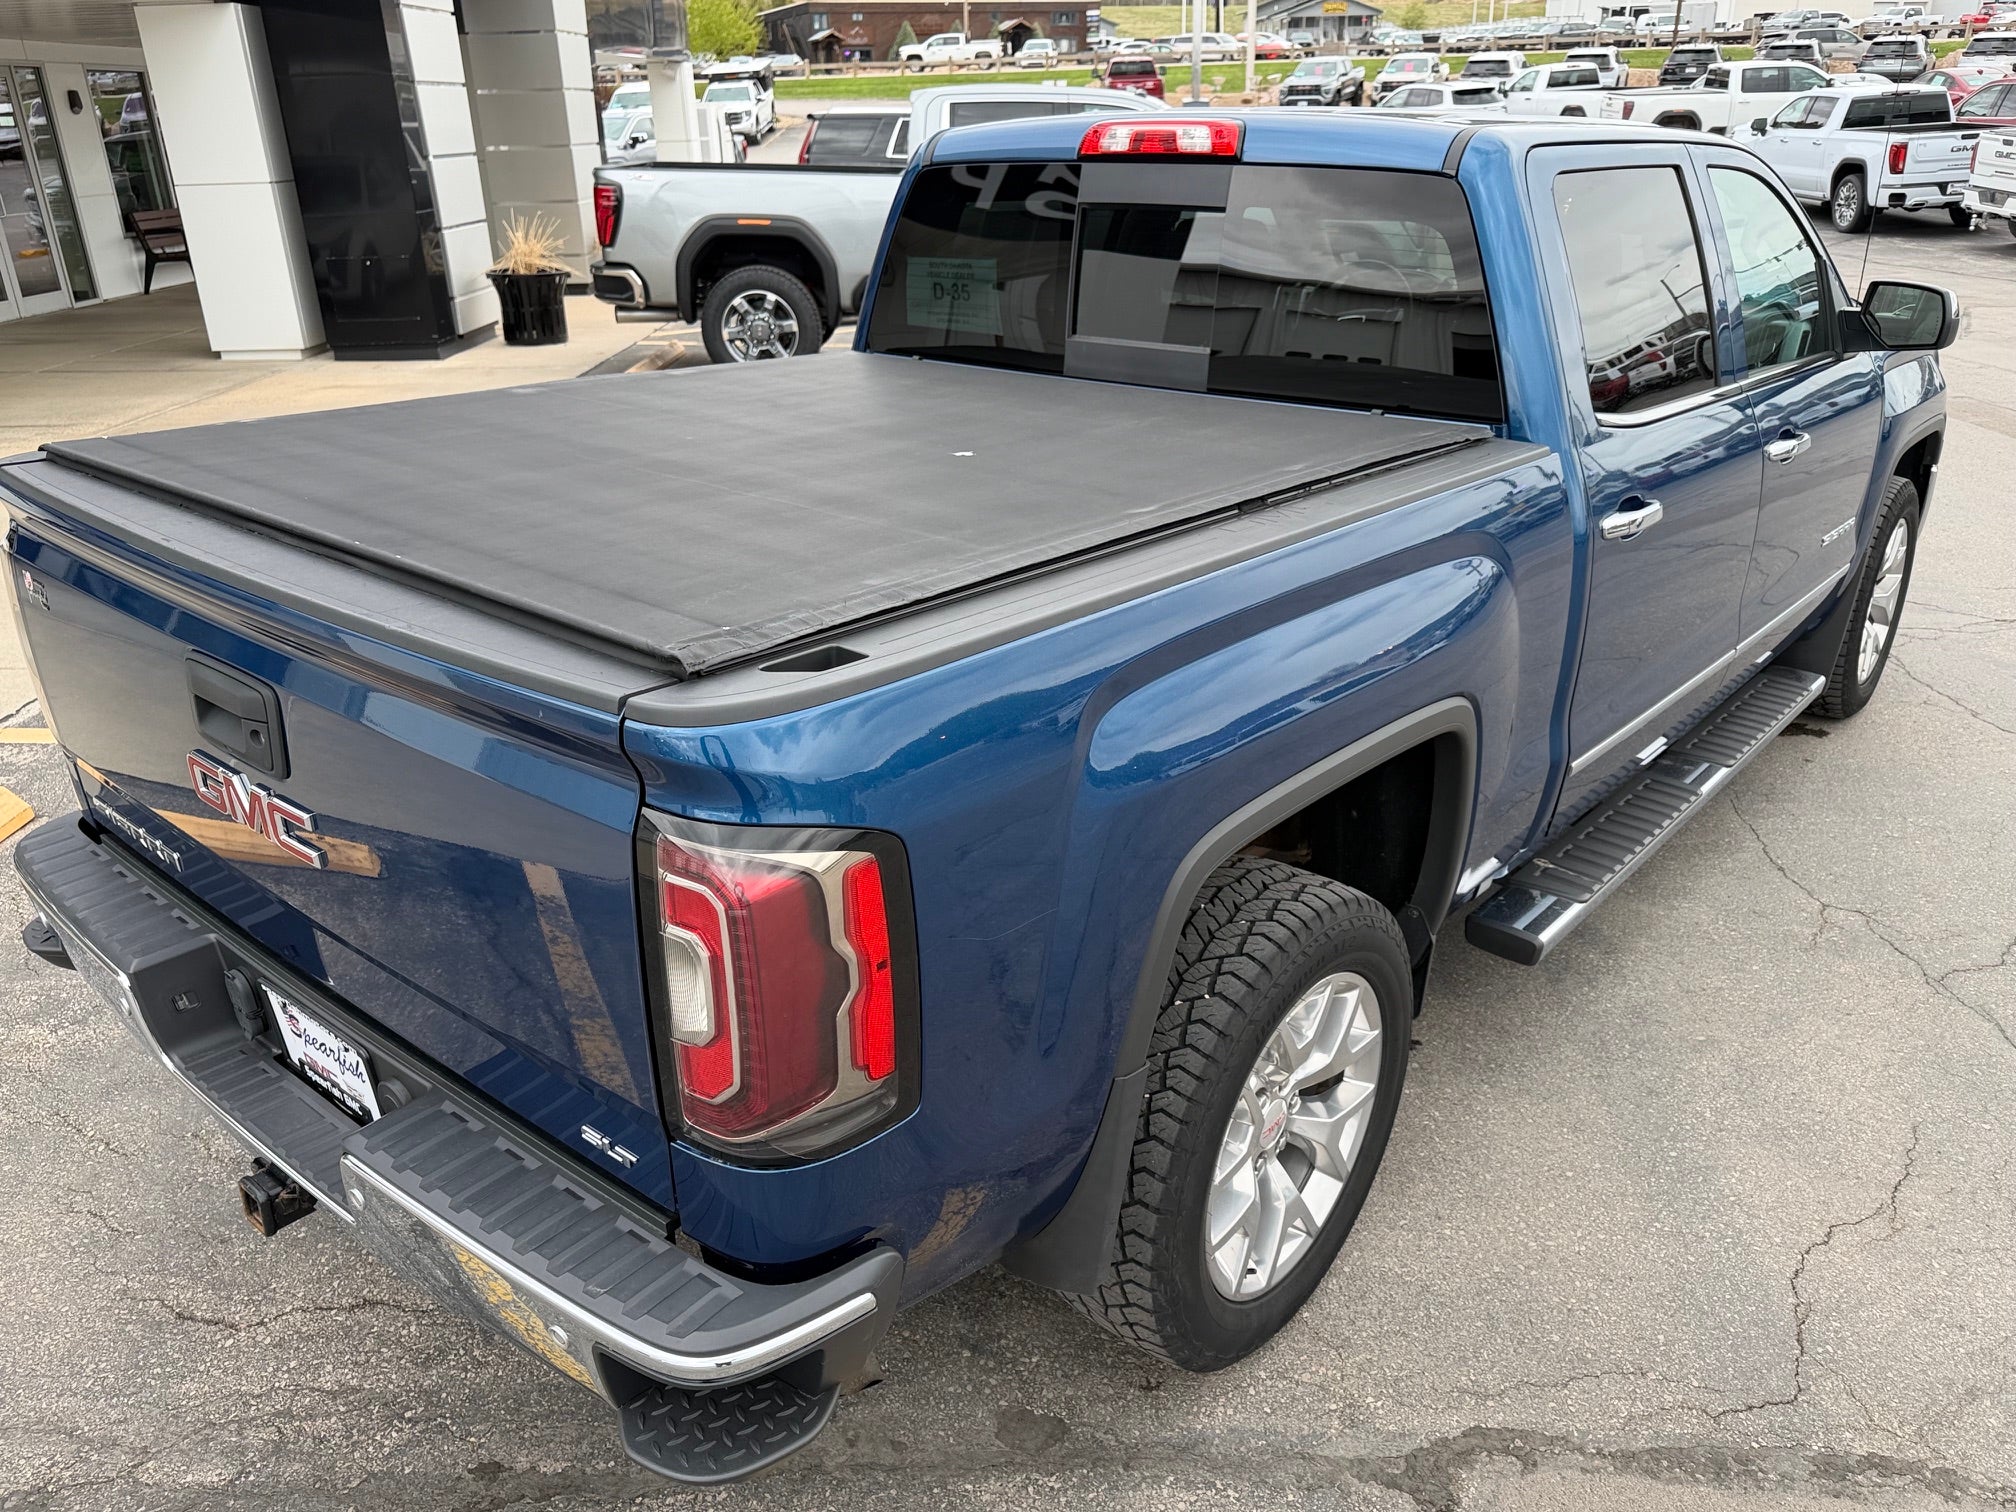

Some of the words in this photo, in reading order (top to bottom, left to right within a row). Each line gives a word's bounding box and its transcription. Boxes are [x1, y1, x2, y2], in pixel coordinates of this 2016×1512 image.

[1951, 144, 1975, 153] GM
[933, 282, 971, 302] D-35
[186, 748, 330, 870] GMC
[285, 1011, 366, 1084] Spearfish
[342, 1092, 363, 1116] GMC
[581, 1123, 640, 1169] SLT
